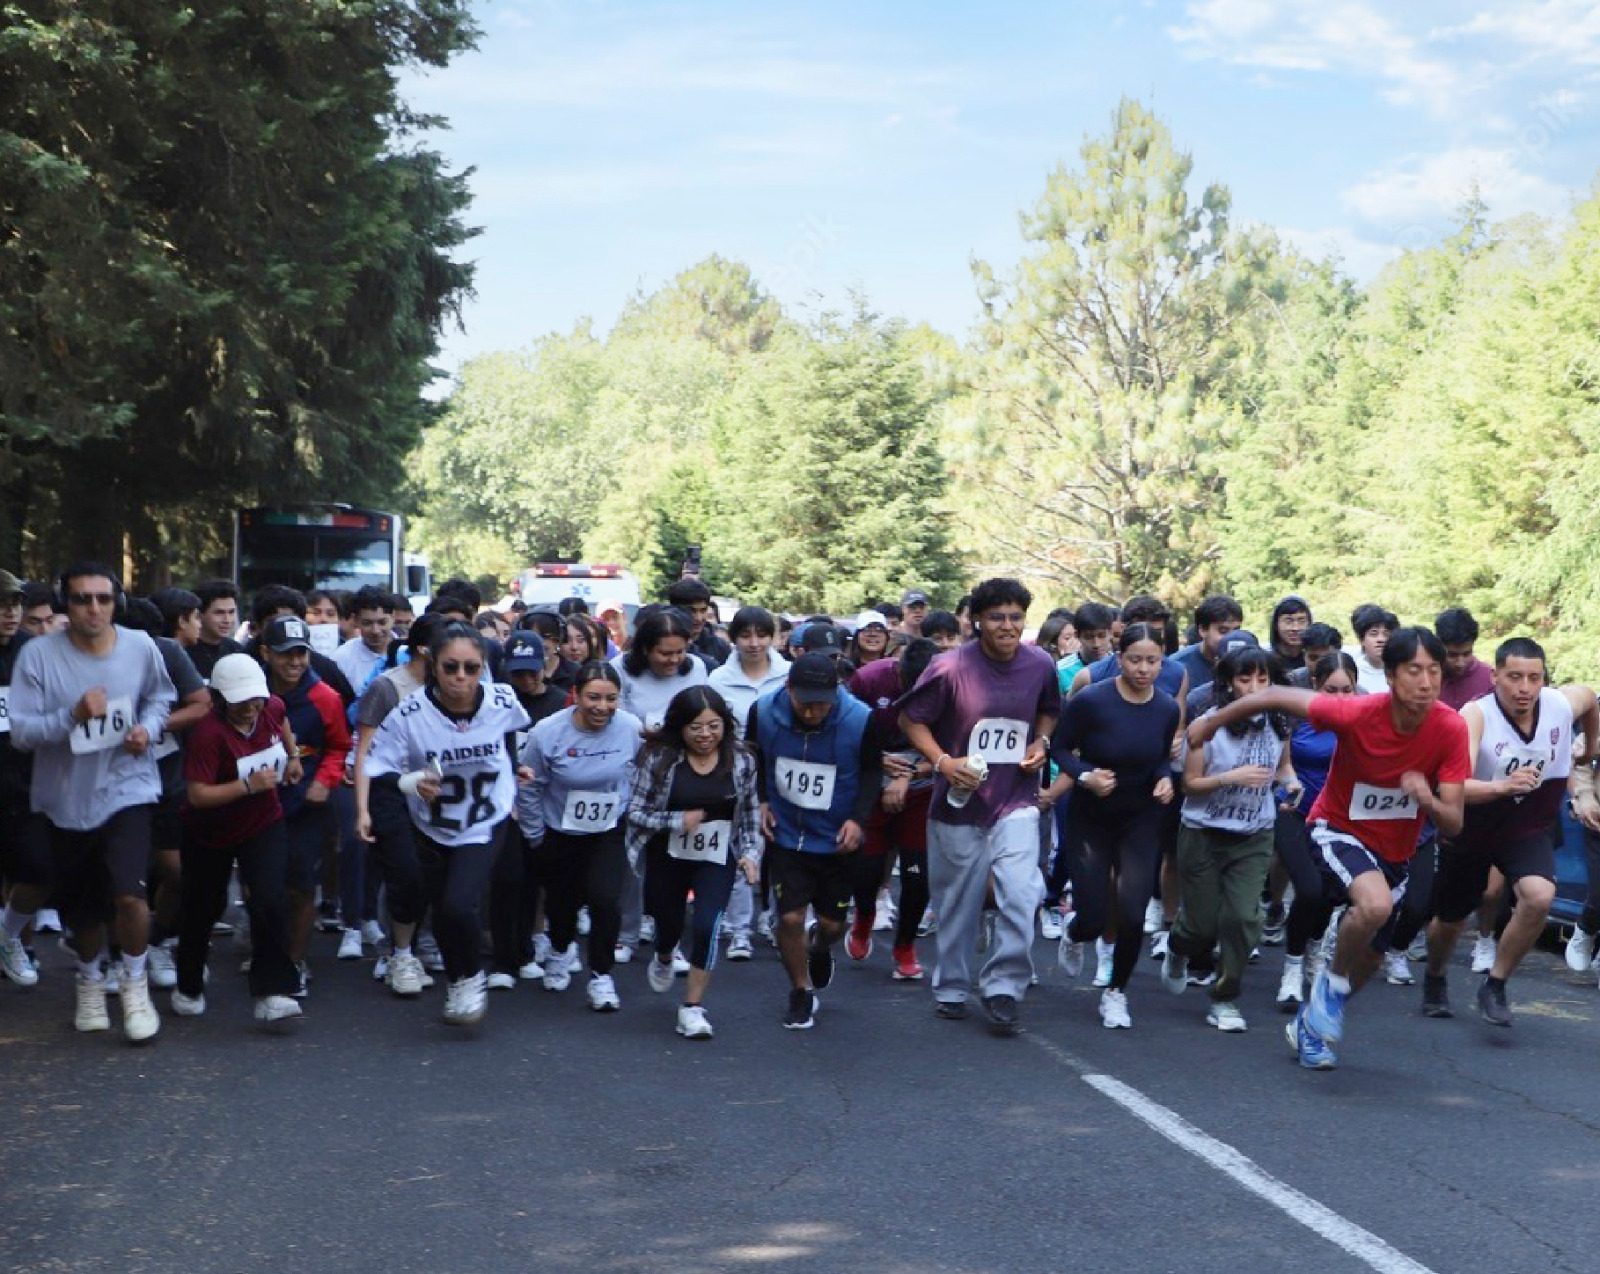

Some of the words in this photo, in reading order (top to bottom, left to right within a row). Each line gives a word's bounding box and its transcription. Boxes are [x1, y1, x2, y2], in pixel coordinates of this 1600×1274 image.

[80, 709, 124, 739] 176
[978, 729, 1018, 750] 076
[784, 768, 824, 797] 195
[574, 800, 614, 821] 037
[1363, 792, 1409, 811] 024
[679, 830, 718, 851] 184
